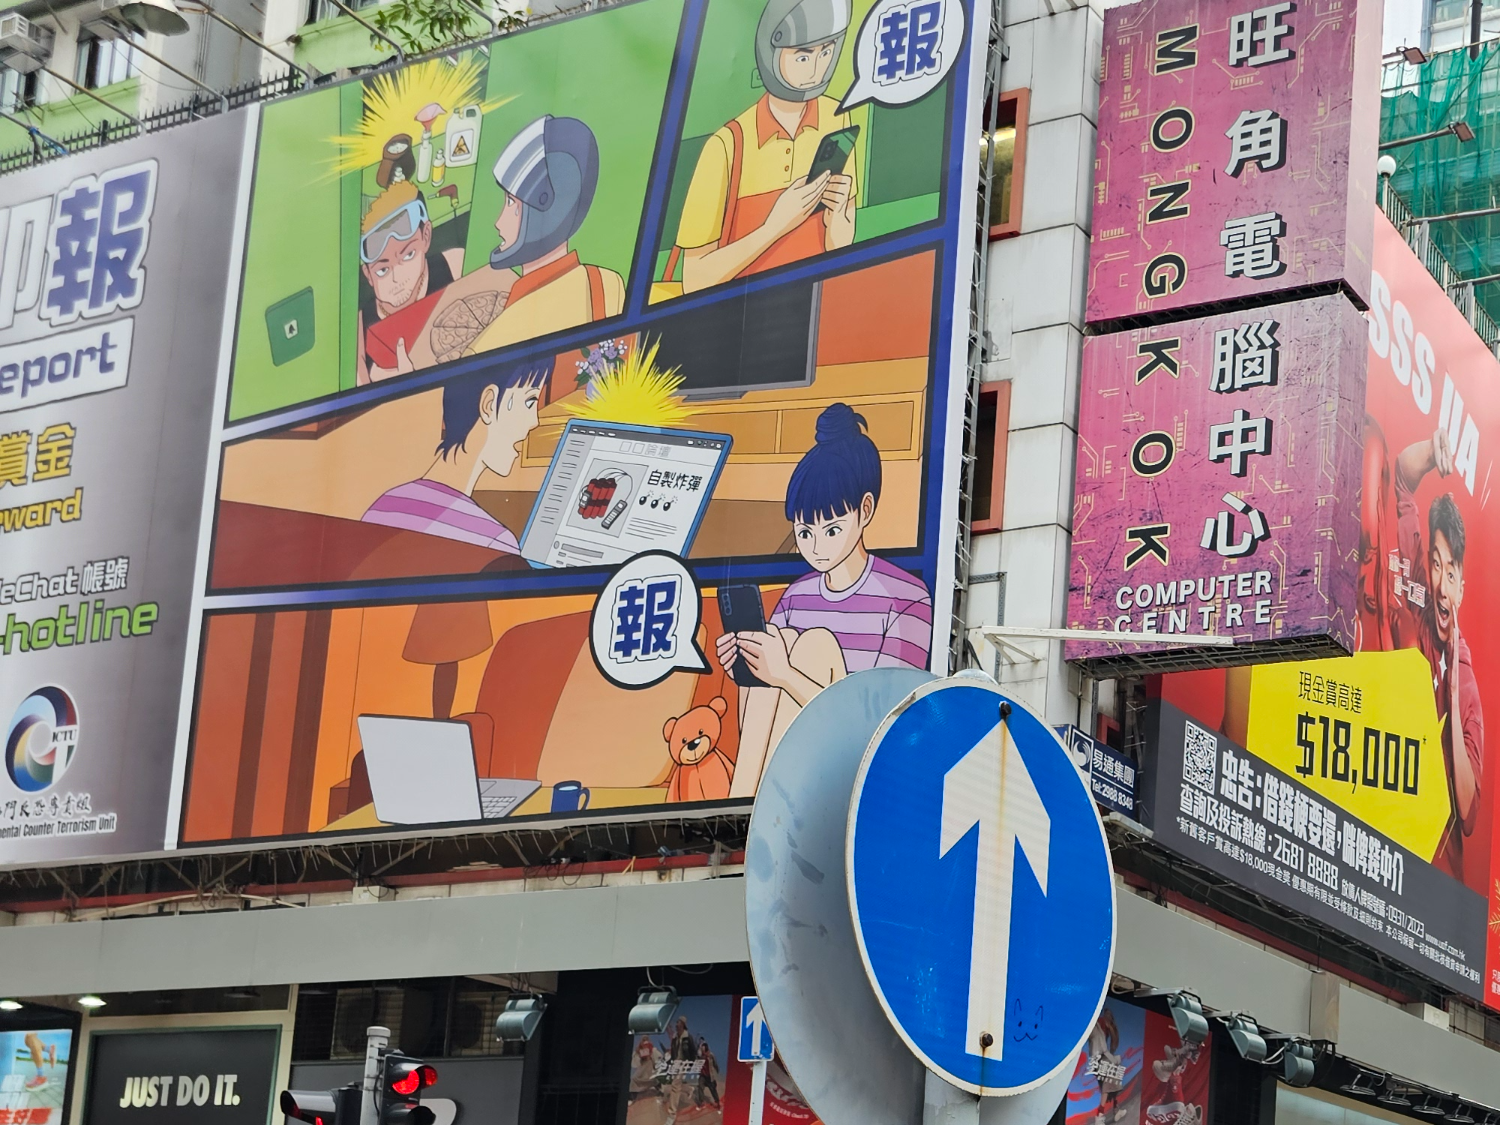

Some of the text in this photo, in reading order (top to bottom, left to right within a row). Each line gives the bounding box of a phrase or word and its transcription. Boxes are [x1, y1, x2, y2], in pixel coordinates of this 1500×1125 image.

[877, 0, 943, 83] 報
[1123, 22, 1200, 572] MONG KOK
[1200, 1, 1296, 557] 旺角電腦中心
[1438, 370, 1480, 497] UA
[647, 469, 703, 492] 自製炸彈
[0, 487, 84, 533] ward
[0, 556, 130, 605] eChat 帳號
[1115, 570, 1273, 610] COMPUTER
[616, 579, 678, 662] 報
[1114, 600, 1272, 636] CENTRE
[1298, 671, 1363, 714] 現金賞高達
[1092, 748, 1135, 789] 易通集團
[23, 820, 54, 837] Counter
[57, 817, 97, 834] Terrorism
[99, 814, 116, 830] Unit
[1307, 853, 1339, 891] 8888
[119, 1074, 241, 1108] JUST DO IT.
